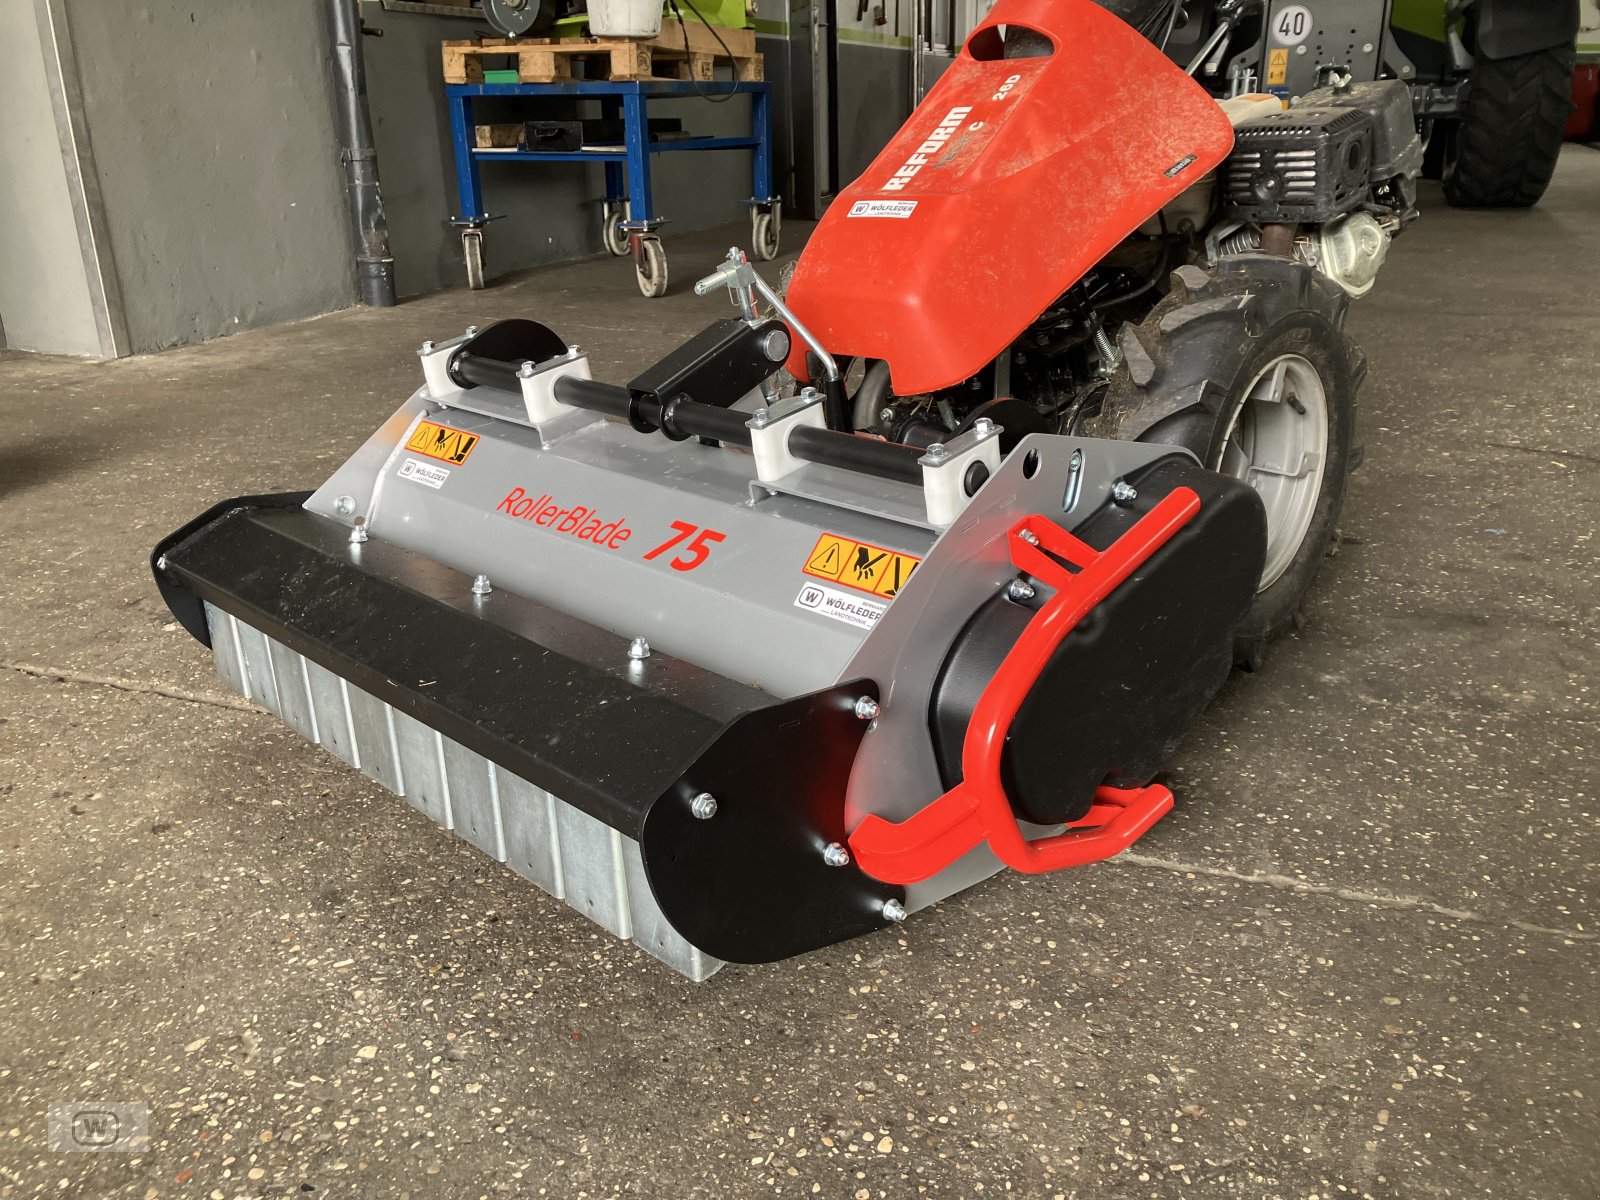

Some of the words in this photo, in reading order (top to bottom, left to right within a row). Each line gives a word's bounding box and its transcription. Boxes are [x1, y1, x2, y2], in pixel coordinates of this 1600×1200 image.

[1279, 12, 1305, 36] 40
[881, 106, 973, 191] REFORM
[870, 203, 914, 212] WÖLFLEDER
[496, 487, 632, 550] RollerBlade
[642, 519, 727, 572] 75
[805, 591, 819, 604] W
